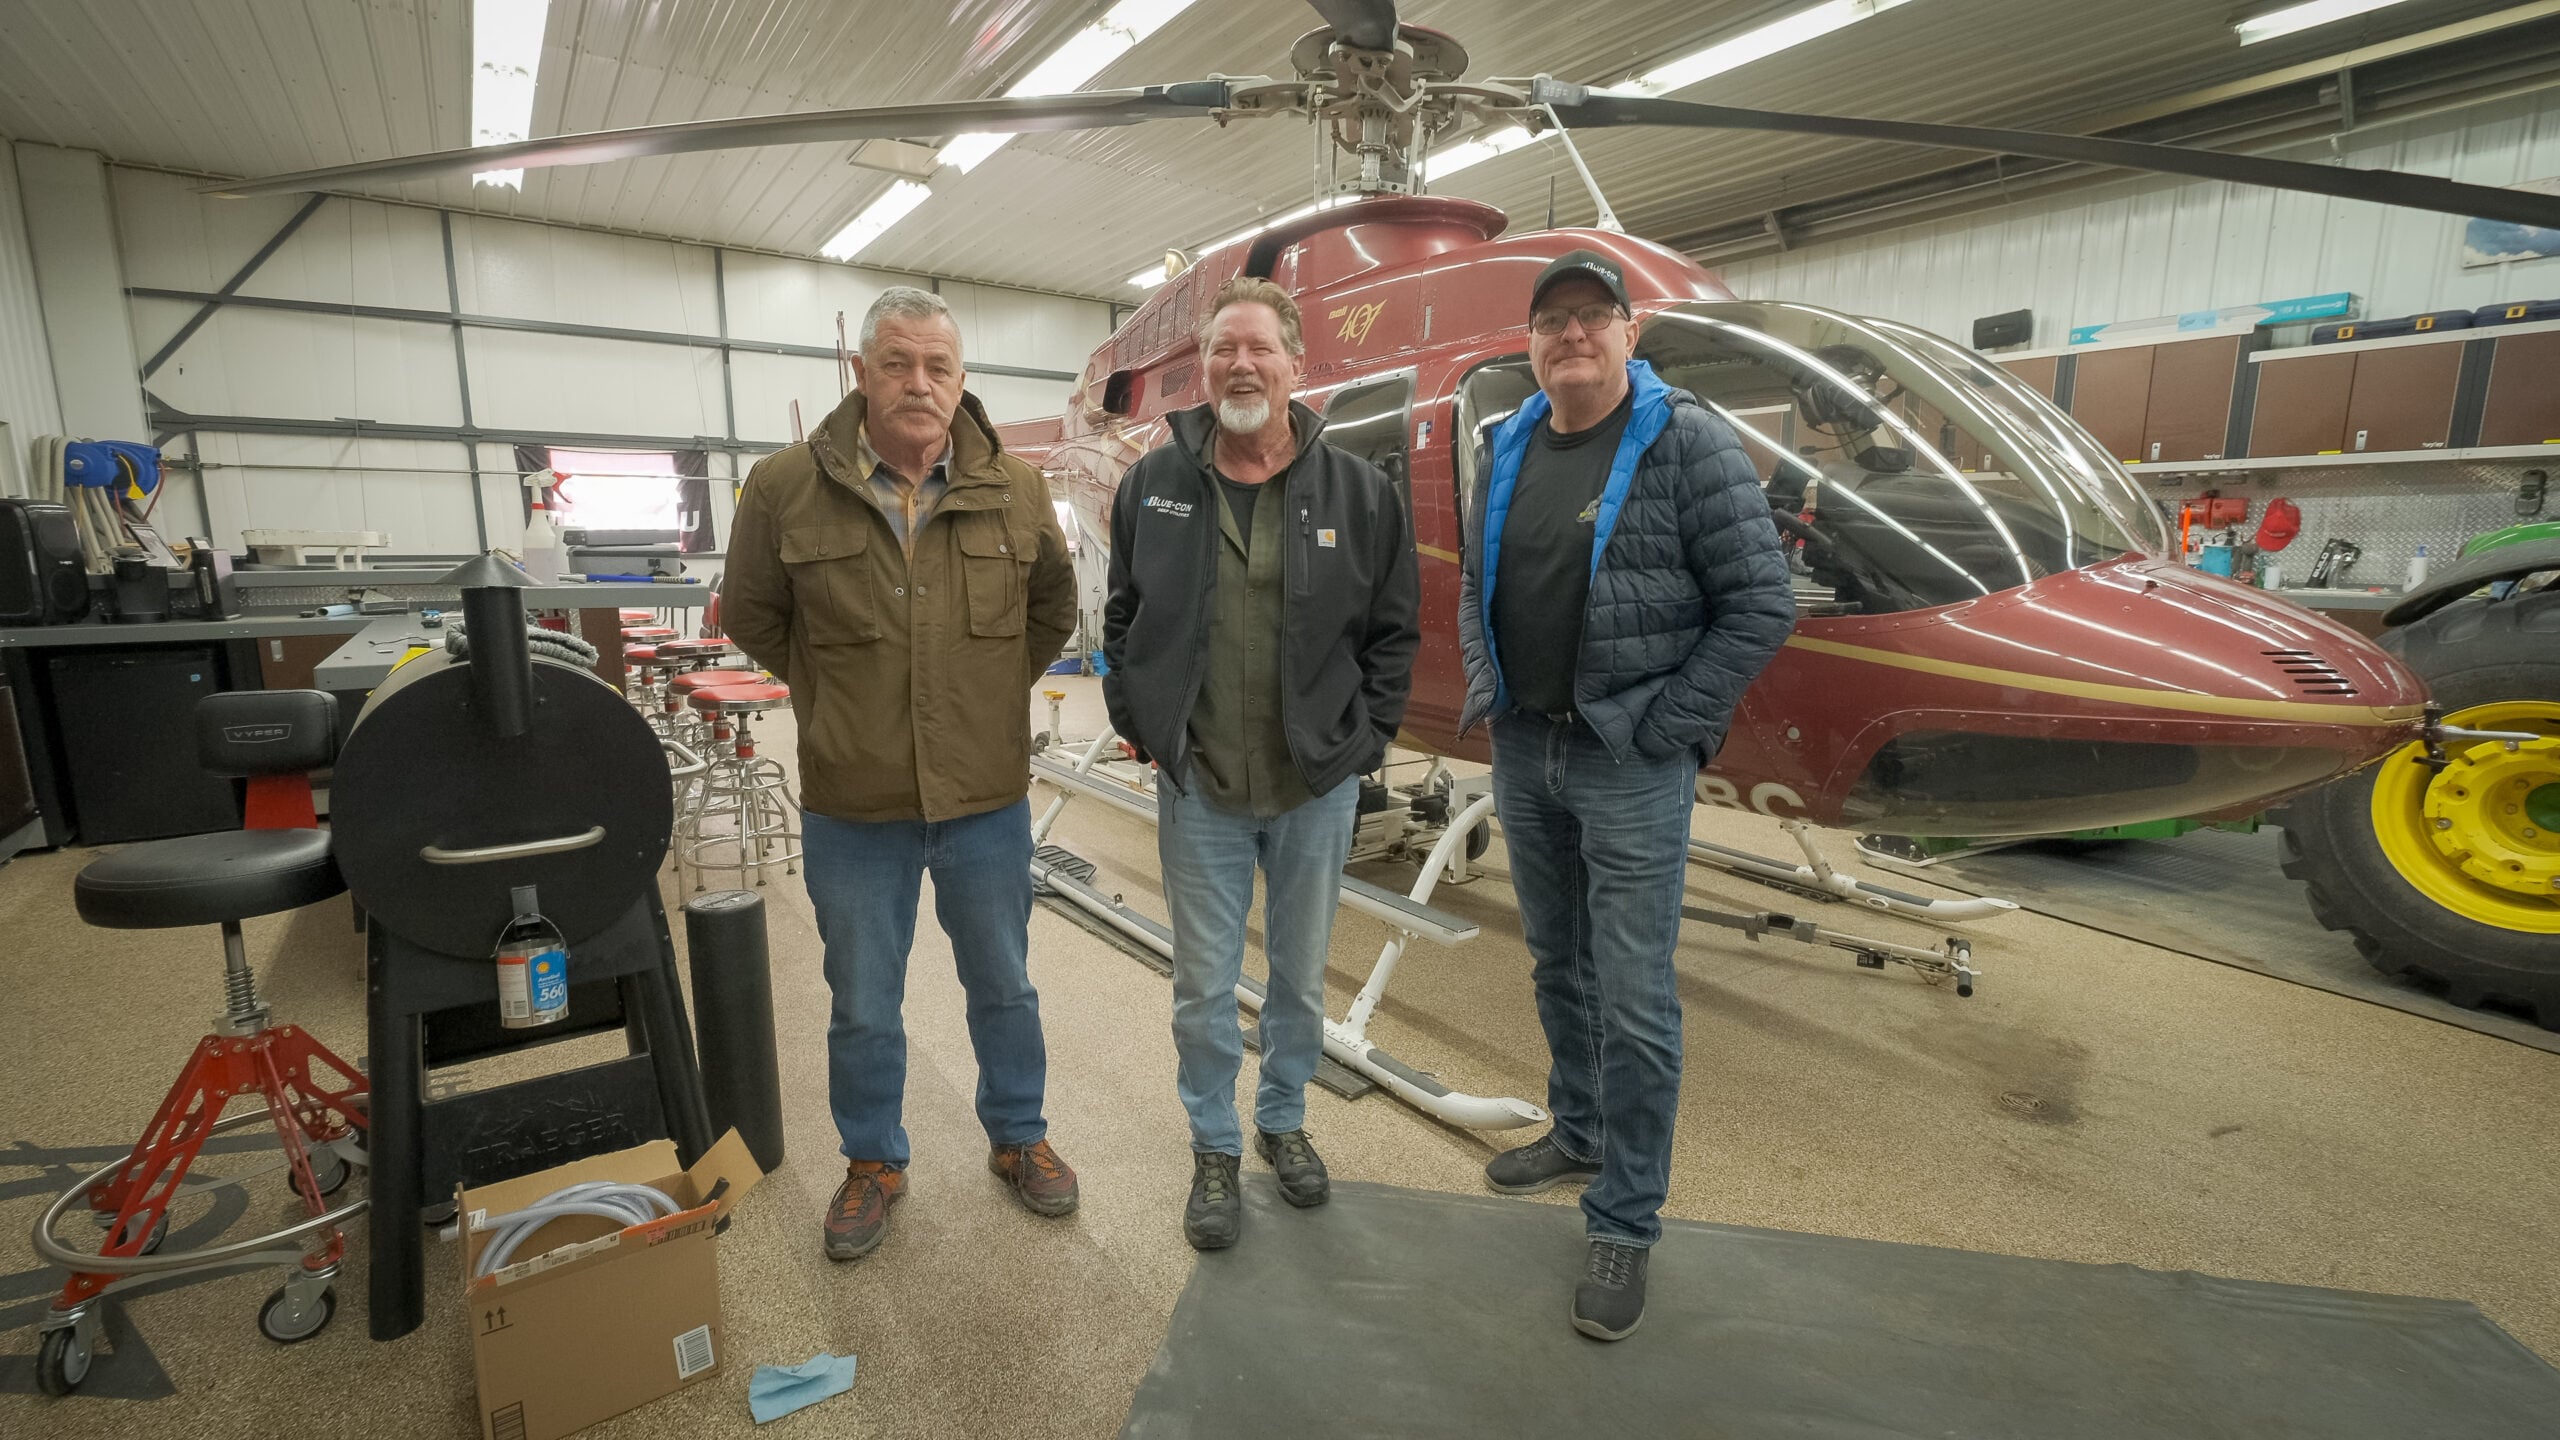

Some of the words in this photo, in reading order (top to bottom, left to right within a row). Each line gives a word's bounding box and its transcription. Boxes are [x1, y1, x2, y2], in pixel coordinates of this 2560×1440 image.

[1335, 298, 1388, 347] 407
[1148, 495, 1193, 512] BLUE-CON
[233, 728, 284, 738] VYPER
[539, 983, 565, 1002] 560
[466, 1112, 629, 1169] TRAEGER
